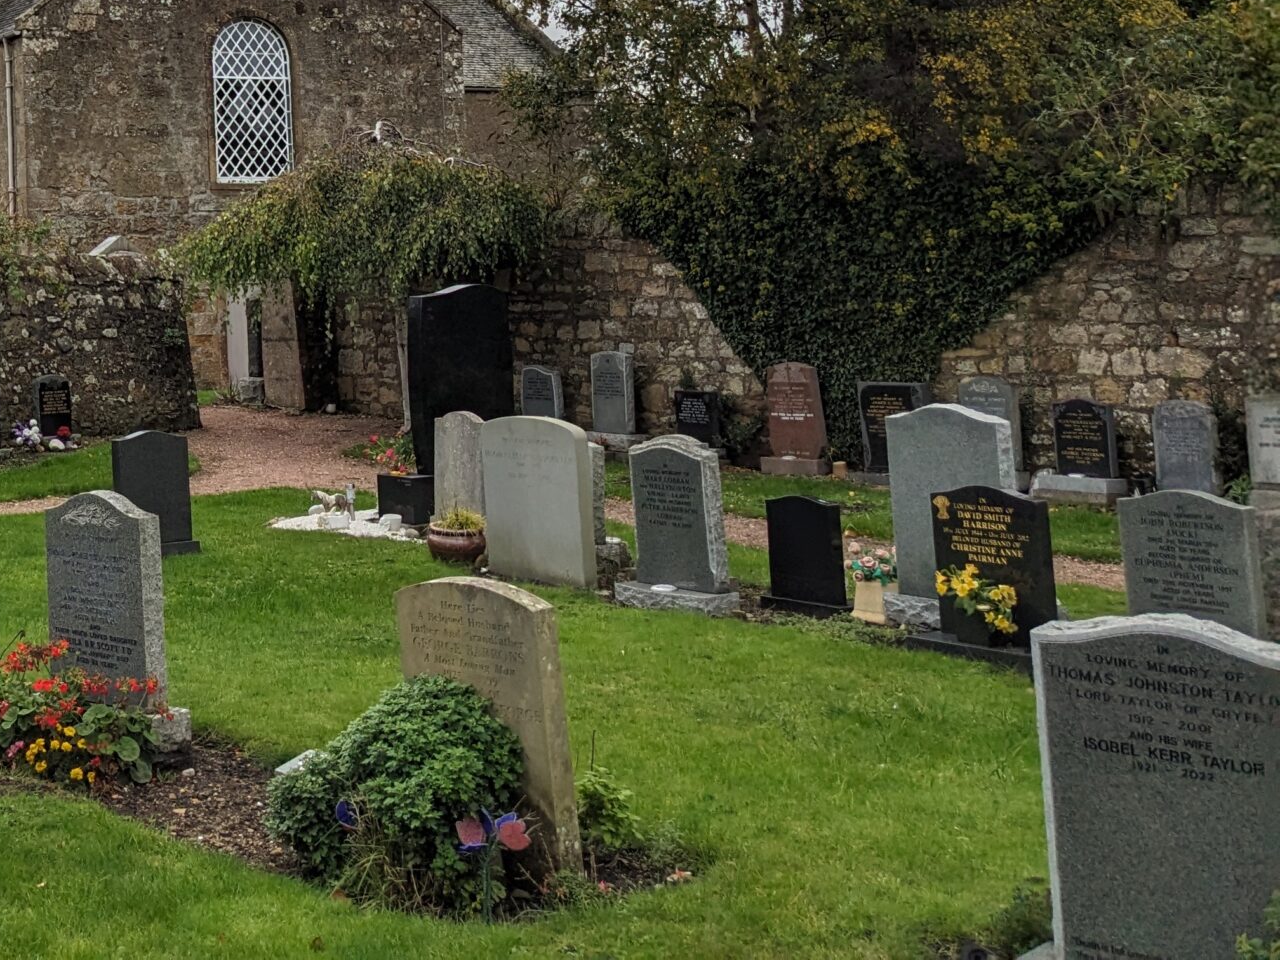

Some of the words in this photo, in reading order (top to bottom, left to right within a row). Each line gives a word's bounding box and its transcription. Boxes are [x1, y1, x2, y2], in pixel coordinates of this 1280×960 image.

[957, 510, 982, 519] DAVID
[984, 513, 1011, 522] SMITH
[962, 520, 1007, 530] HARRISON
[1139, 517, 1164, 526] JOHN
[1169, 519, 1223, 531] ROBERTSON
[981, 538, 1011, 546] HUSBAND
[950, 542, 997, 554] CHRISTINE
[999, 547, 1024, 558] ANNE
[968, 553, 1008, 564] PAIRMAN
[1133, 557, 1183, 570] EUPHEMIA
[1187, 562, 1239, 576] ANDERSON
[440, 600, 463, 611] Here
[410, 623, 440, 634] Father
[467, 617, 510, 633] Husband
[412, 636, 463, 655] GEORGE
[1157, 644, 1169, 656] IN
[433, 655, 455, 666] Most
[1086, 653, 1138, 669] LOVING
[1147, 661, 1210, 679] MEMORY
[1224, 671, 1246, 683] OF
[1048, 664, 1116, 687] THOMAS
[1126, 677, 1214, 700] JOHNSTON
[1119, 695, 1173, 713] TAYLOR
[1184, 704, 1201, 716] OF
[1128, 731, 1153, 743] AND
[1158, 735, 1178, 747] HIS
[1183, 738, 1214, 751] WIFE
[1083, 736, 1141, 757] ISOBEL
[1148, 746, 1193, 765] KERR
[1200, 754, 1266, 777] TAYLOR
